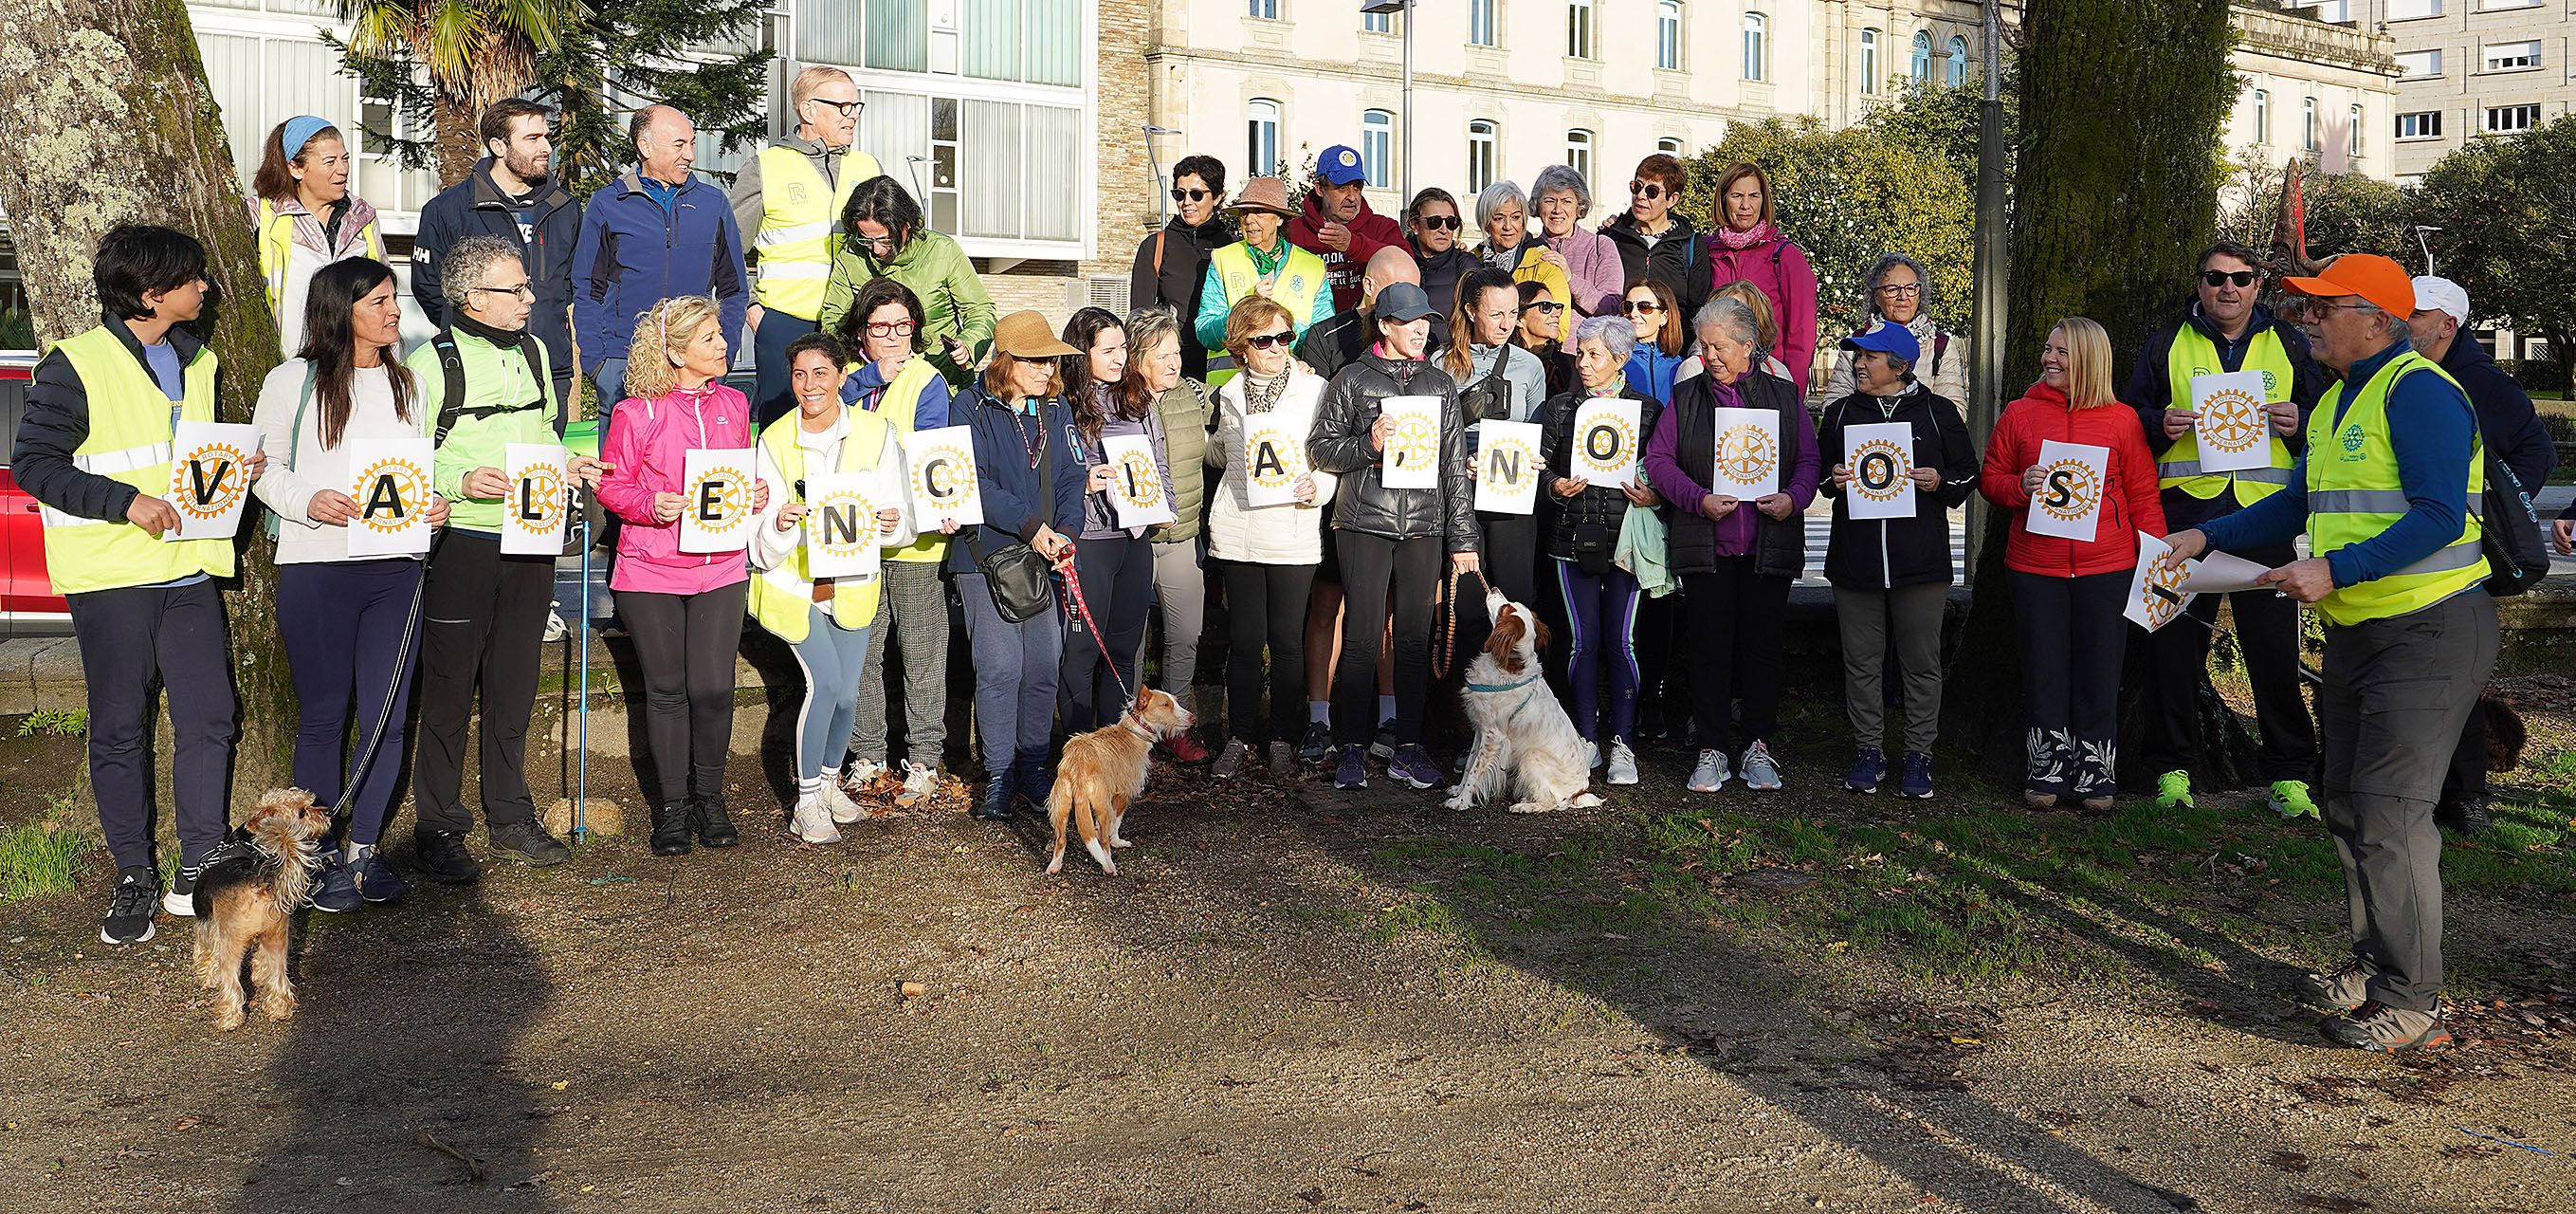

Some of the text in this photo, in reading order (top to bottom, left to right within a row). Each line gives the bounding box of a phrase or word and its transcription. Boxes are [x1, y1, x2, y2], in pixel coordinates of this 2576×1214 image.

[411, 245, 430, 265] HH
[2215, 395, 2242, 404] ROTARY
[202, 451, 234, 461] ROTARY
[1586, 425, 1619, 461] O
[1865, 445, 1891, 454] ROTARY
[2209, 429, 2256, 446] INTERNATIONAL
[925, 458, 954, 498] C
[1254, 441, 1285, 478] A
[1489, 449, 1520, 485] N
[1860, 452, 1894, 490] O
[190, 460, 230, 506] V
[363, 474, 405, 519] A
[521, 477, 542, 521] L
[700, 481, 724, 521] E
[2045, 470, 2073, 507] S
[823, 505, 857, 545] N
